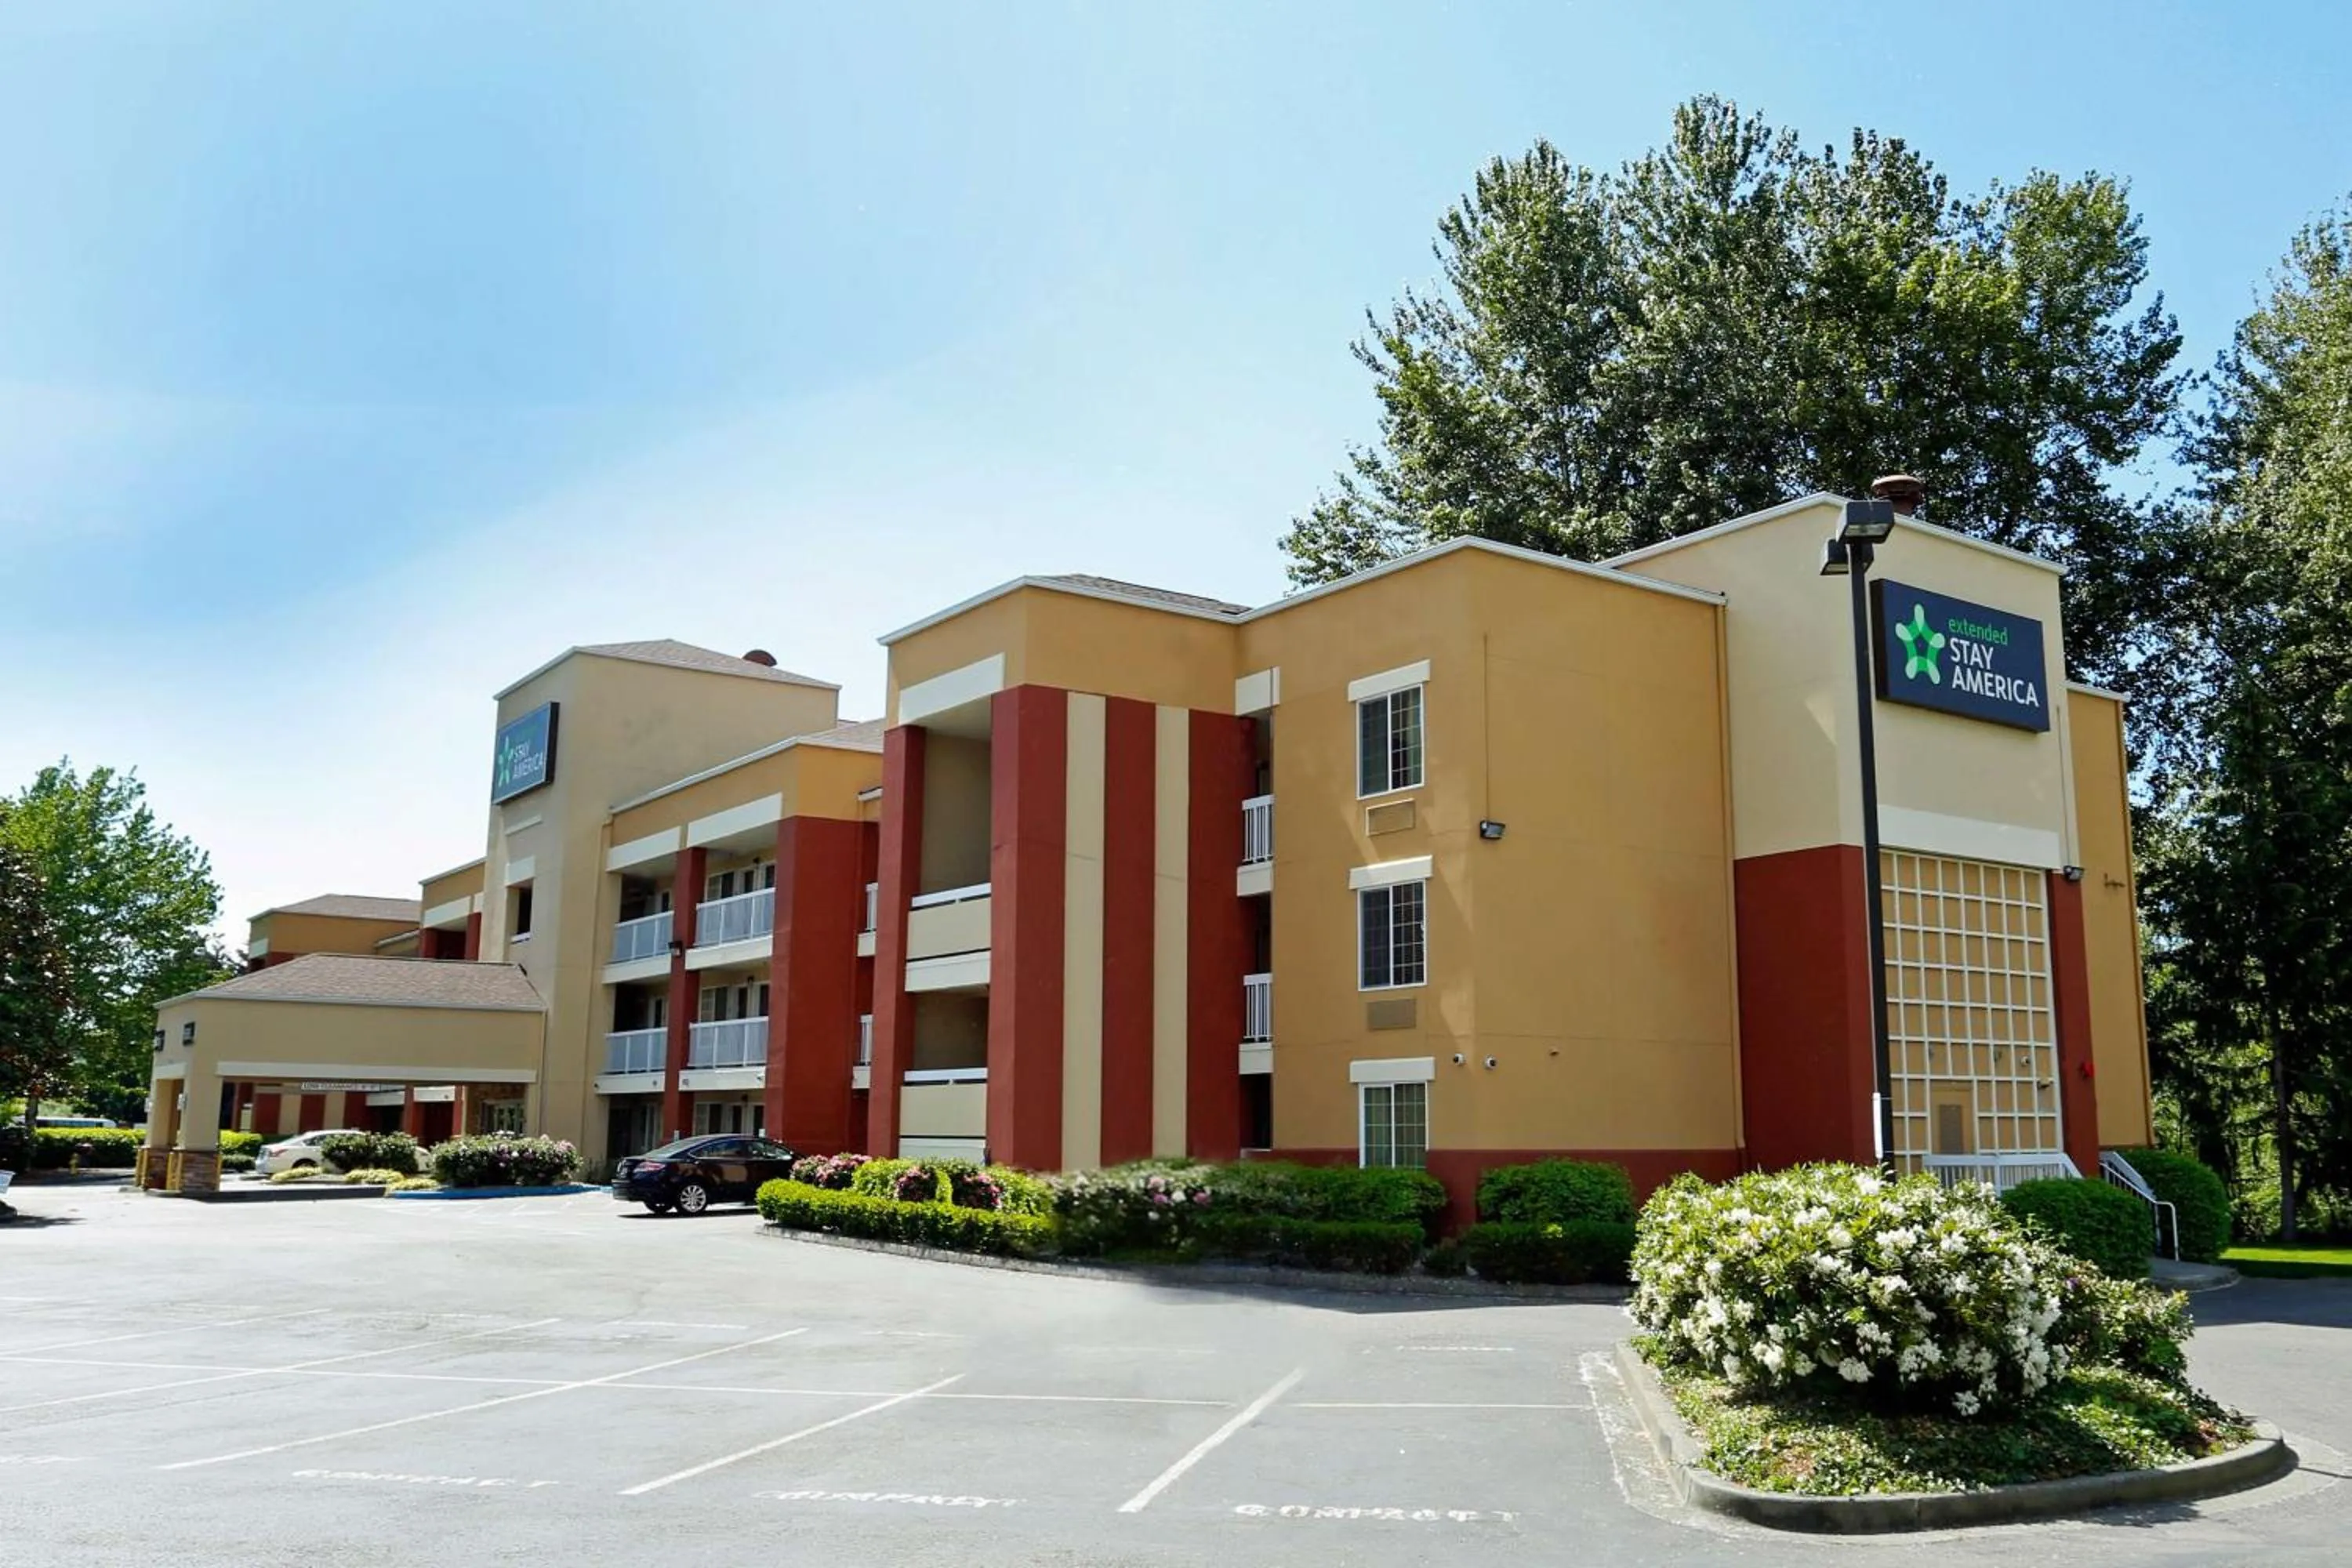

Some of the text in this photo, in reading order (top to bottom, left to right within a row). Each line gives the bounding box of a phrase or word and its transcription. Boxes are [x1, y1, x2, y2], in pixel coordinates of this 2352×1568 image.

[1948, 617, 2009, 646] extended
[1950, 637, 1994, 670] STAY
[1951, 666, 2040, 708] AMERICA
